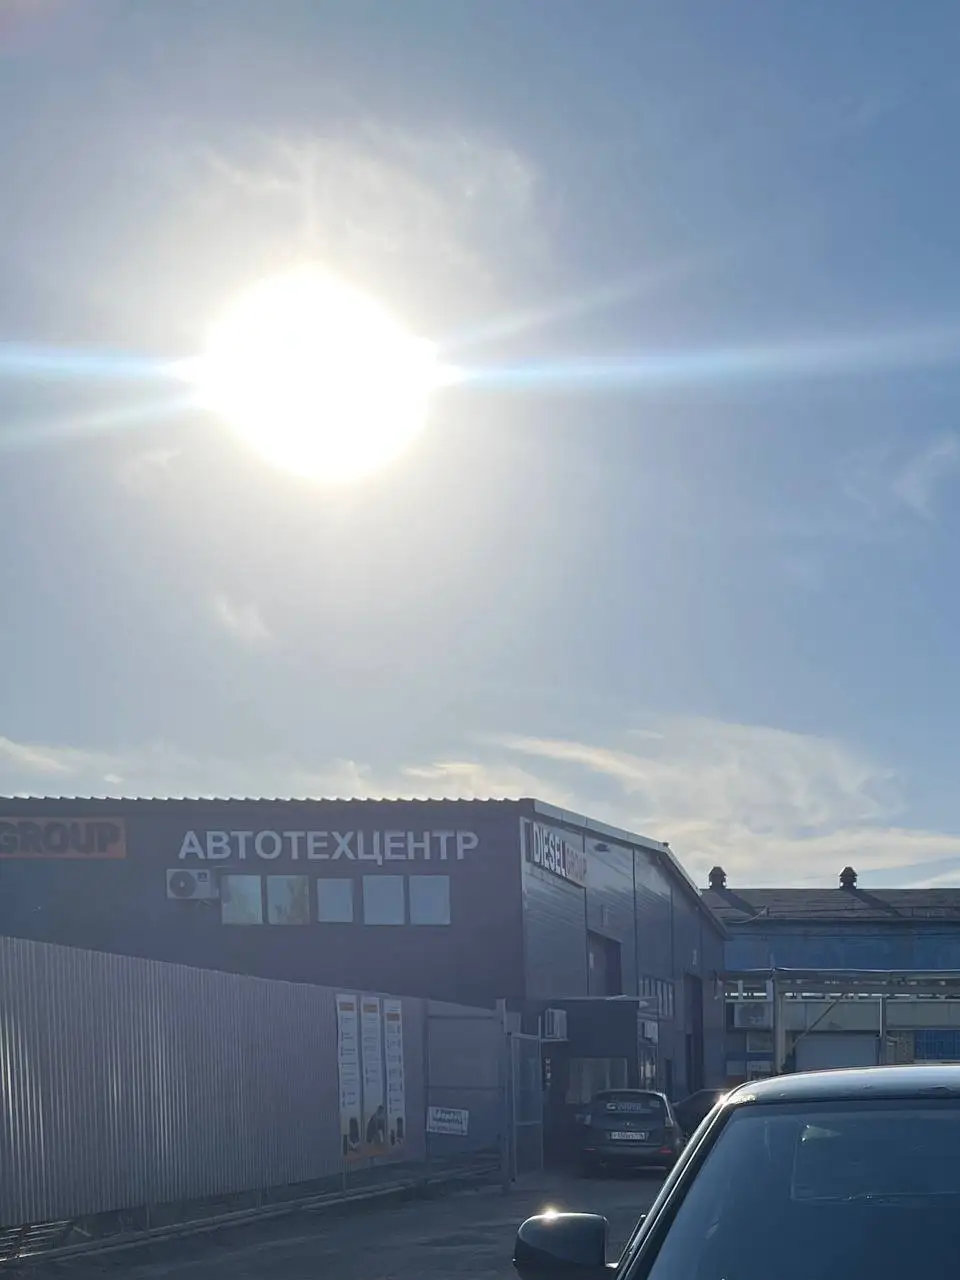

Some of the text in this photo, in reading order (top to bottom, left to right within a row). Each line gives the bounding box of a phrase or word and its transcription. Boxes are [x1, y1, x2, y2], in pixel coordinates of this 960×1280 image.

[0, 821, 120, 855] GROUP
[178, 830, 479, 866] АВТОТЕХЦЕНТР
[533, 821, 567, 877] DIESEL
